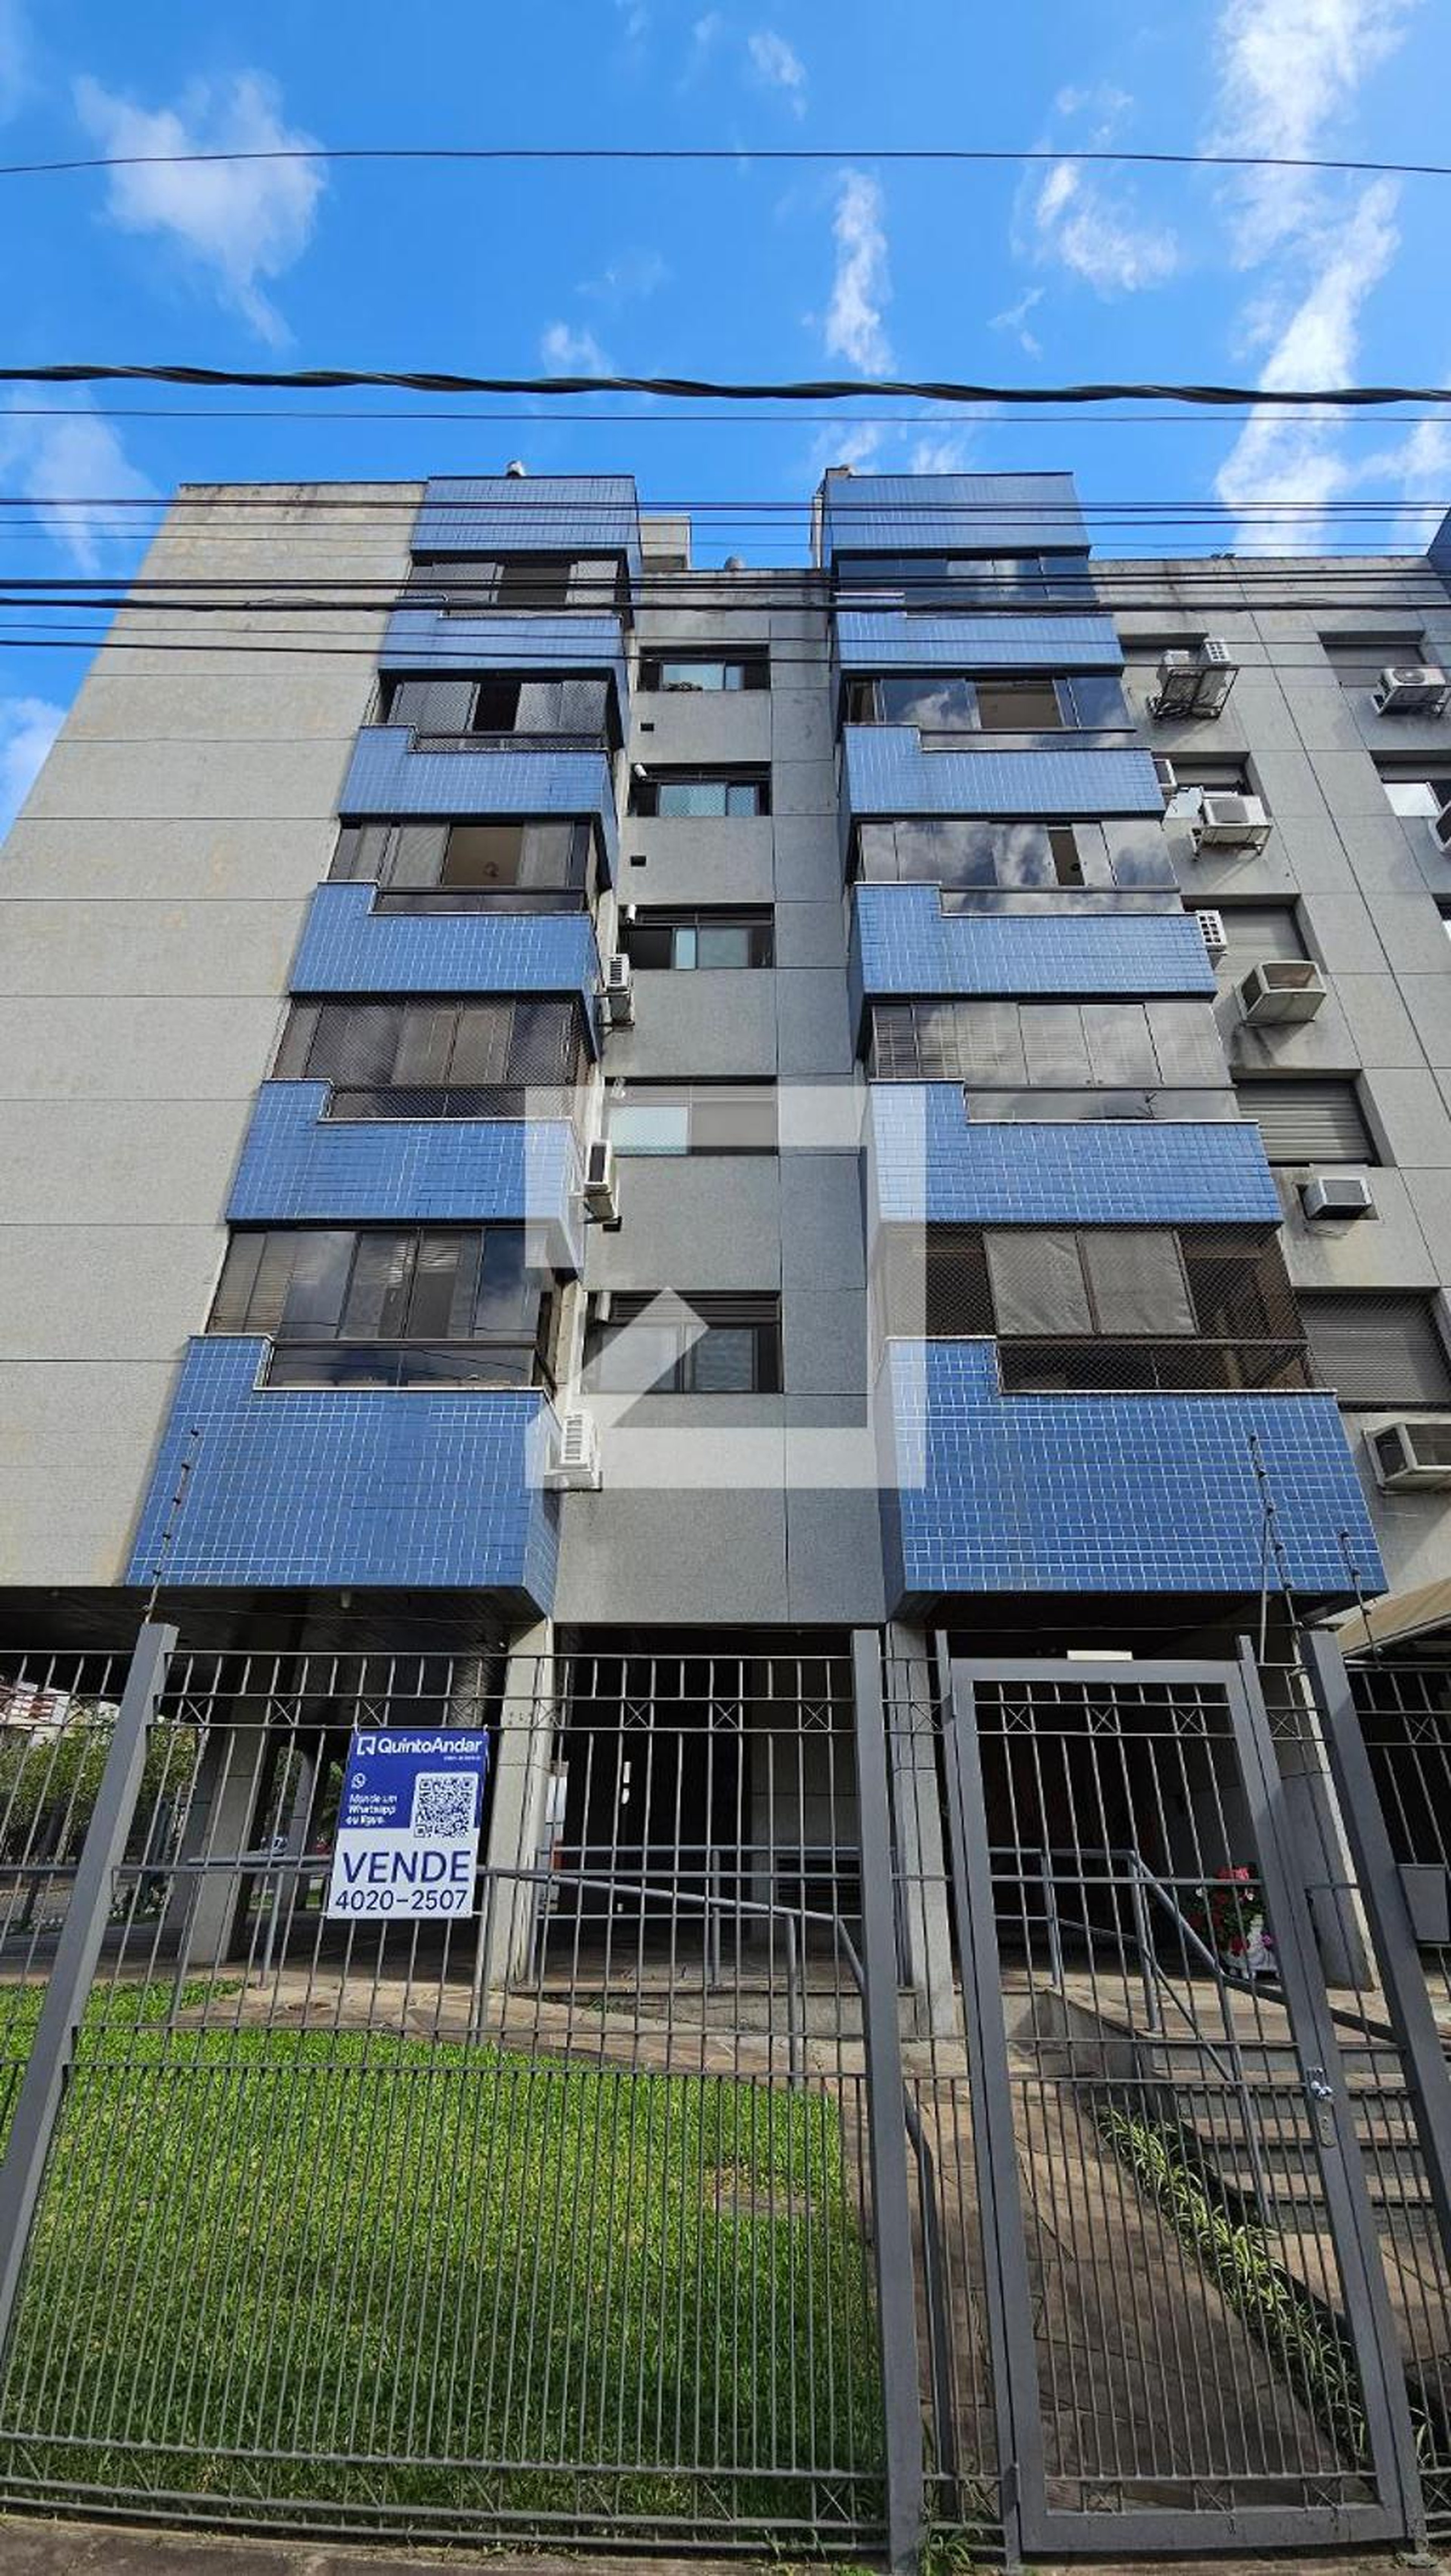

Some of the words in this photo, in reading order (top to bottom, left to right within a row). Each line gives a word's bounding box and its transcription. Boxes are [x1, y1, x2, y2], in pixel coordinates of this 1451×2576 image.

[378, 1737, 482, 1753] QuintoAndar
[343, 1851, 471, 1883] VENDE
[335, 1889, 467, 1911] 4020-2507
